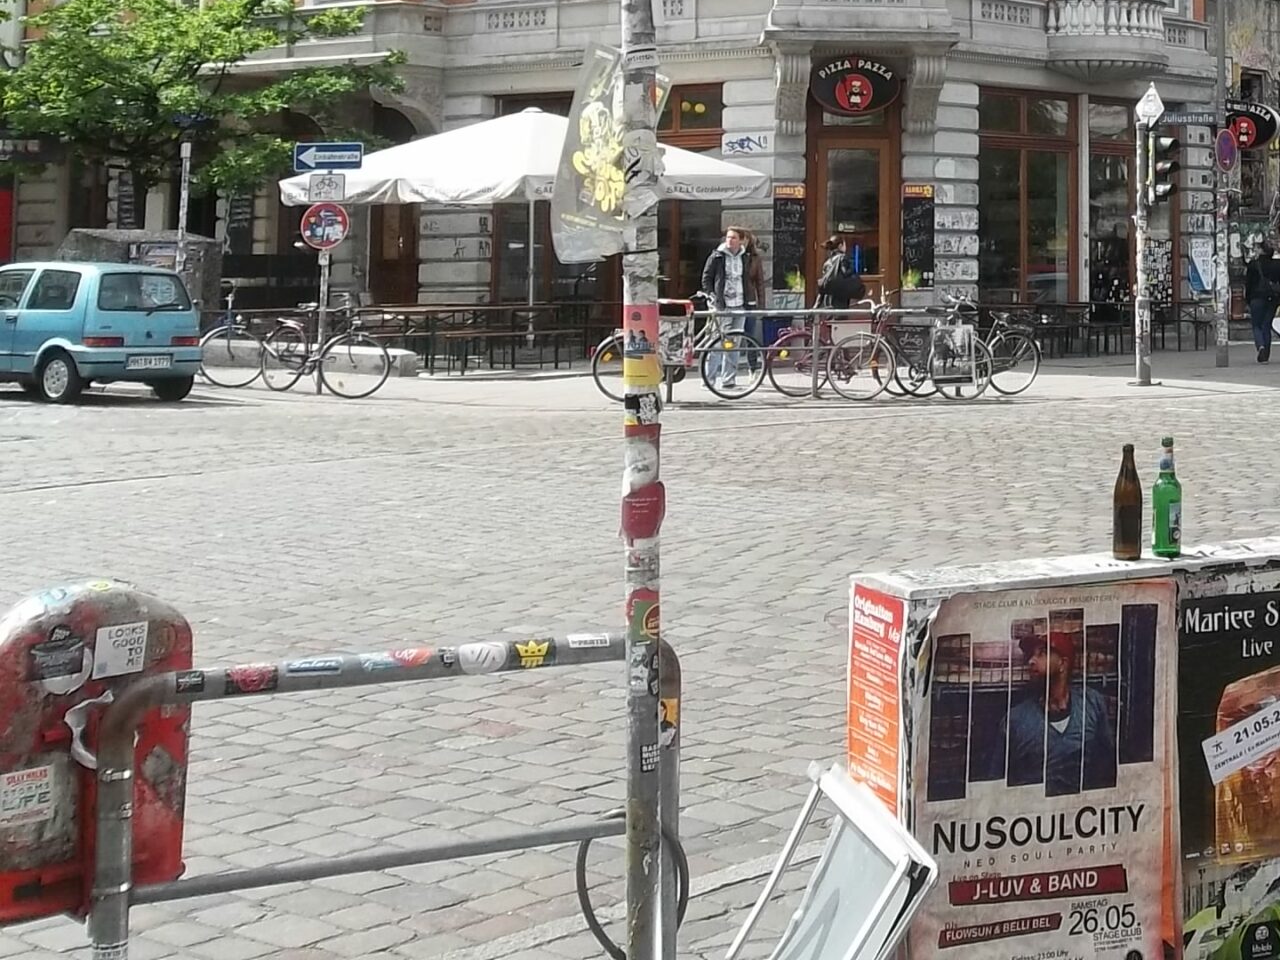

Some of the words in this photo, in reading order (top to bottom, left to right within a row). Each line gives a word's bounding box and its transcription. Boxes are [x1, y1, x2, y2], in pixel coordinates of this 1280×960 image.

[819, 60, 851, 79] PIZZA
[858, 60, 893, 80] PAZZA
[1162, 113, 1214, 123] Juliusstraße
[1185, 606, 1256, 634] Mariee
[108, 625, 145, 639] LOOKS
[112, 636, 144, 649] GOOD
[128, 647, 143, 657] TO
[1242, 638, 1273, 657] Live
[964, 858, 996, 870] NEO
[1010, 851, 1053, 864] SOUL
[1066, 842, 1118, 856] PARTY
[972, 878, 1024, 901] J-LUV
[1029, 878, 1042, 895] &
[1048, 871, 1099, 891] BAND
[1071, 898, 1108, 910] SAMSTAG
[1068, 903, 1142, 936] 26.05.
[946, 925, 993, 941] FLOWSUN
[994, 924, 1001, 935] &
[1003, 920, 1030, 933] BELLI
[1093, 931, 1120, 941] STAGE
[1121, 928, 1142, 938] CLUB
